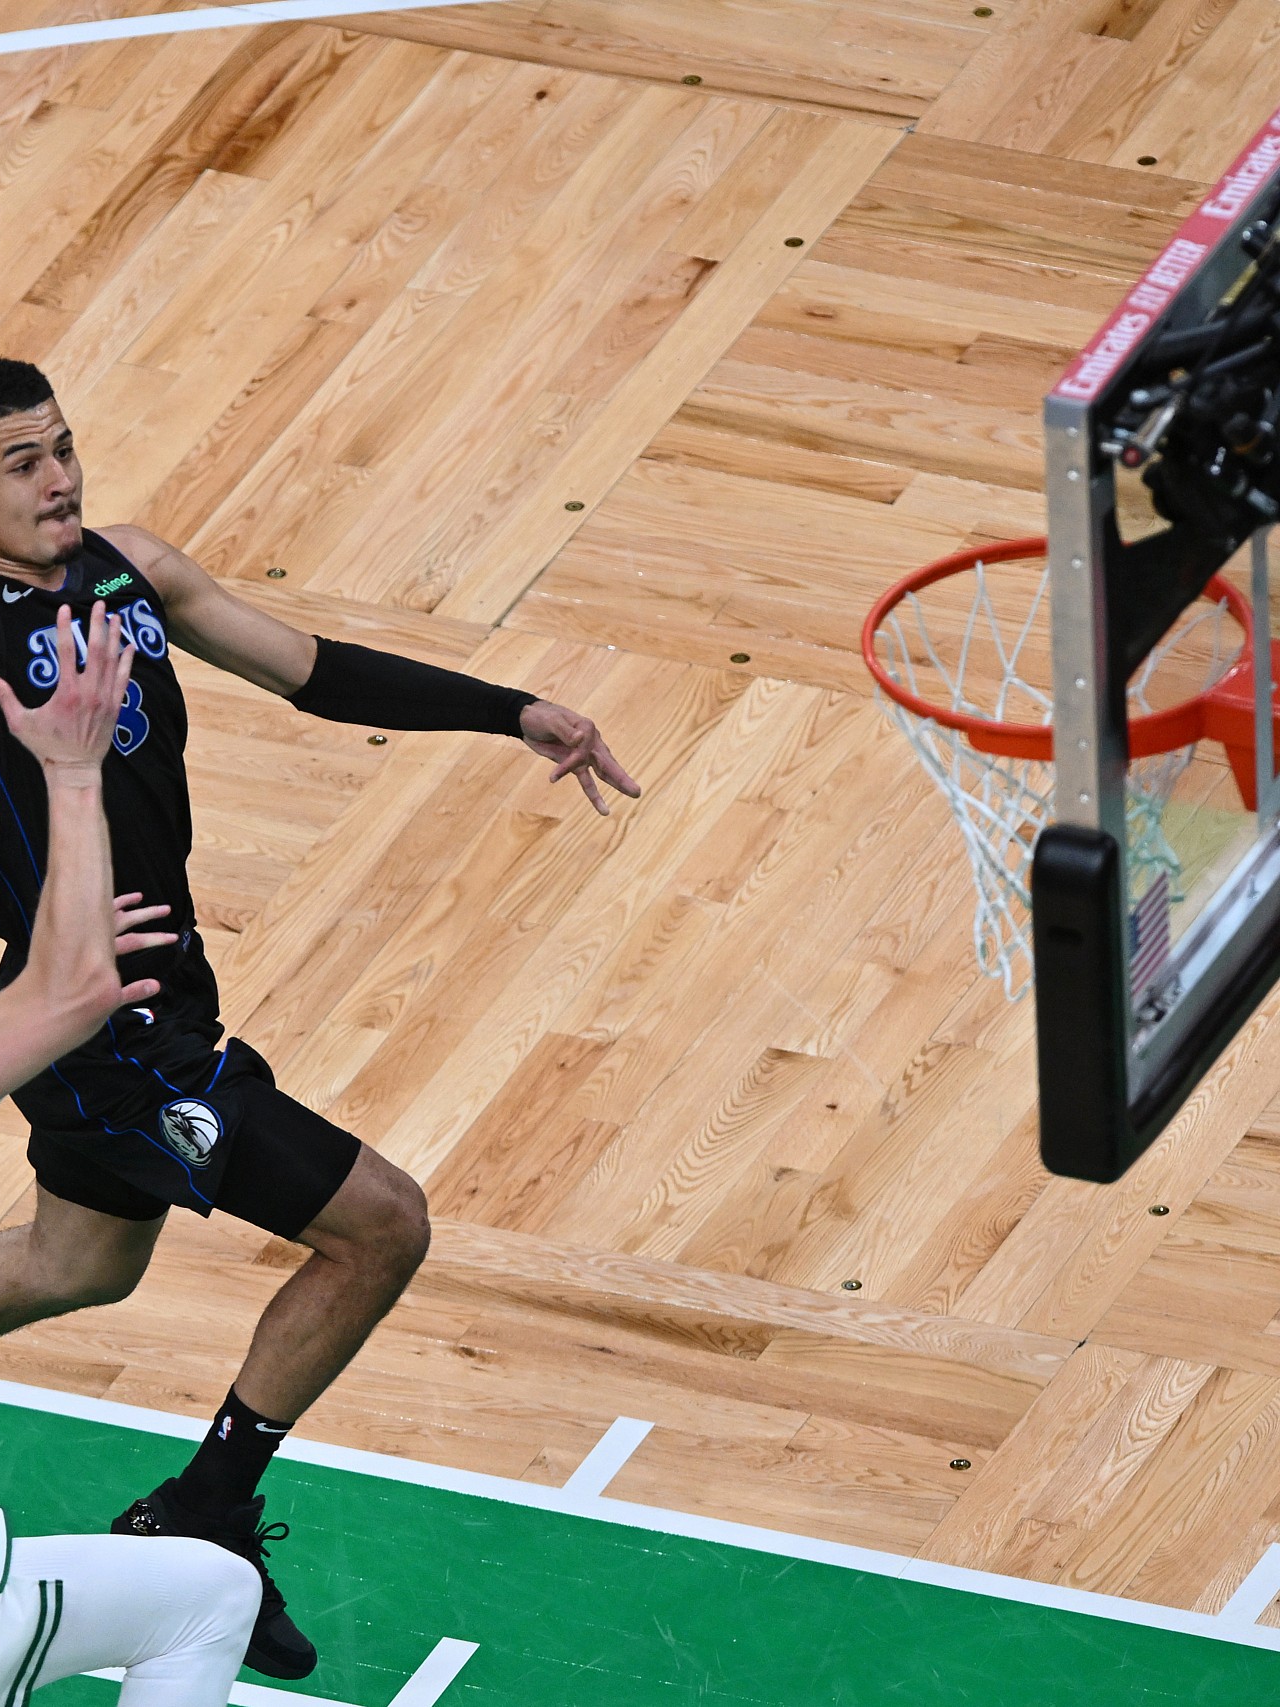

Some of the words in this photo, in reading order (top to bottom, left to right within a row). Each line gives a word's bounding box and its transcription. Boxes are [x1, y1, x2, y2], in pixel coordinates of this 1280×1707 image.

[1059, 312, 1151, 396] Emirates
[1146, 238, 1209, 287] BETTER
[93, 572, 133, 597] chime
